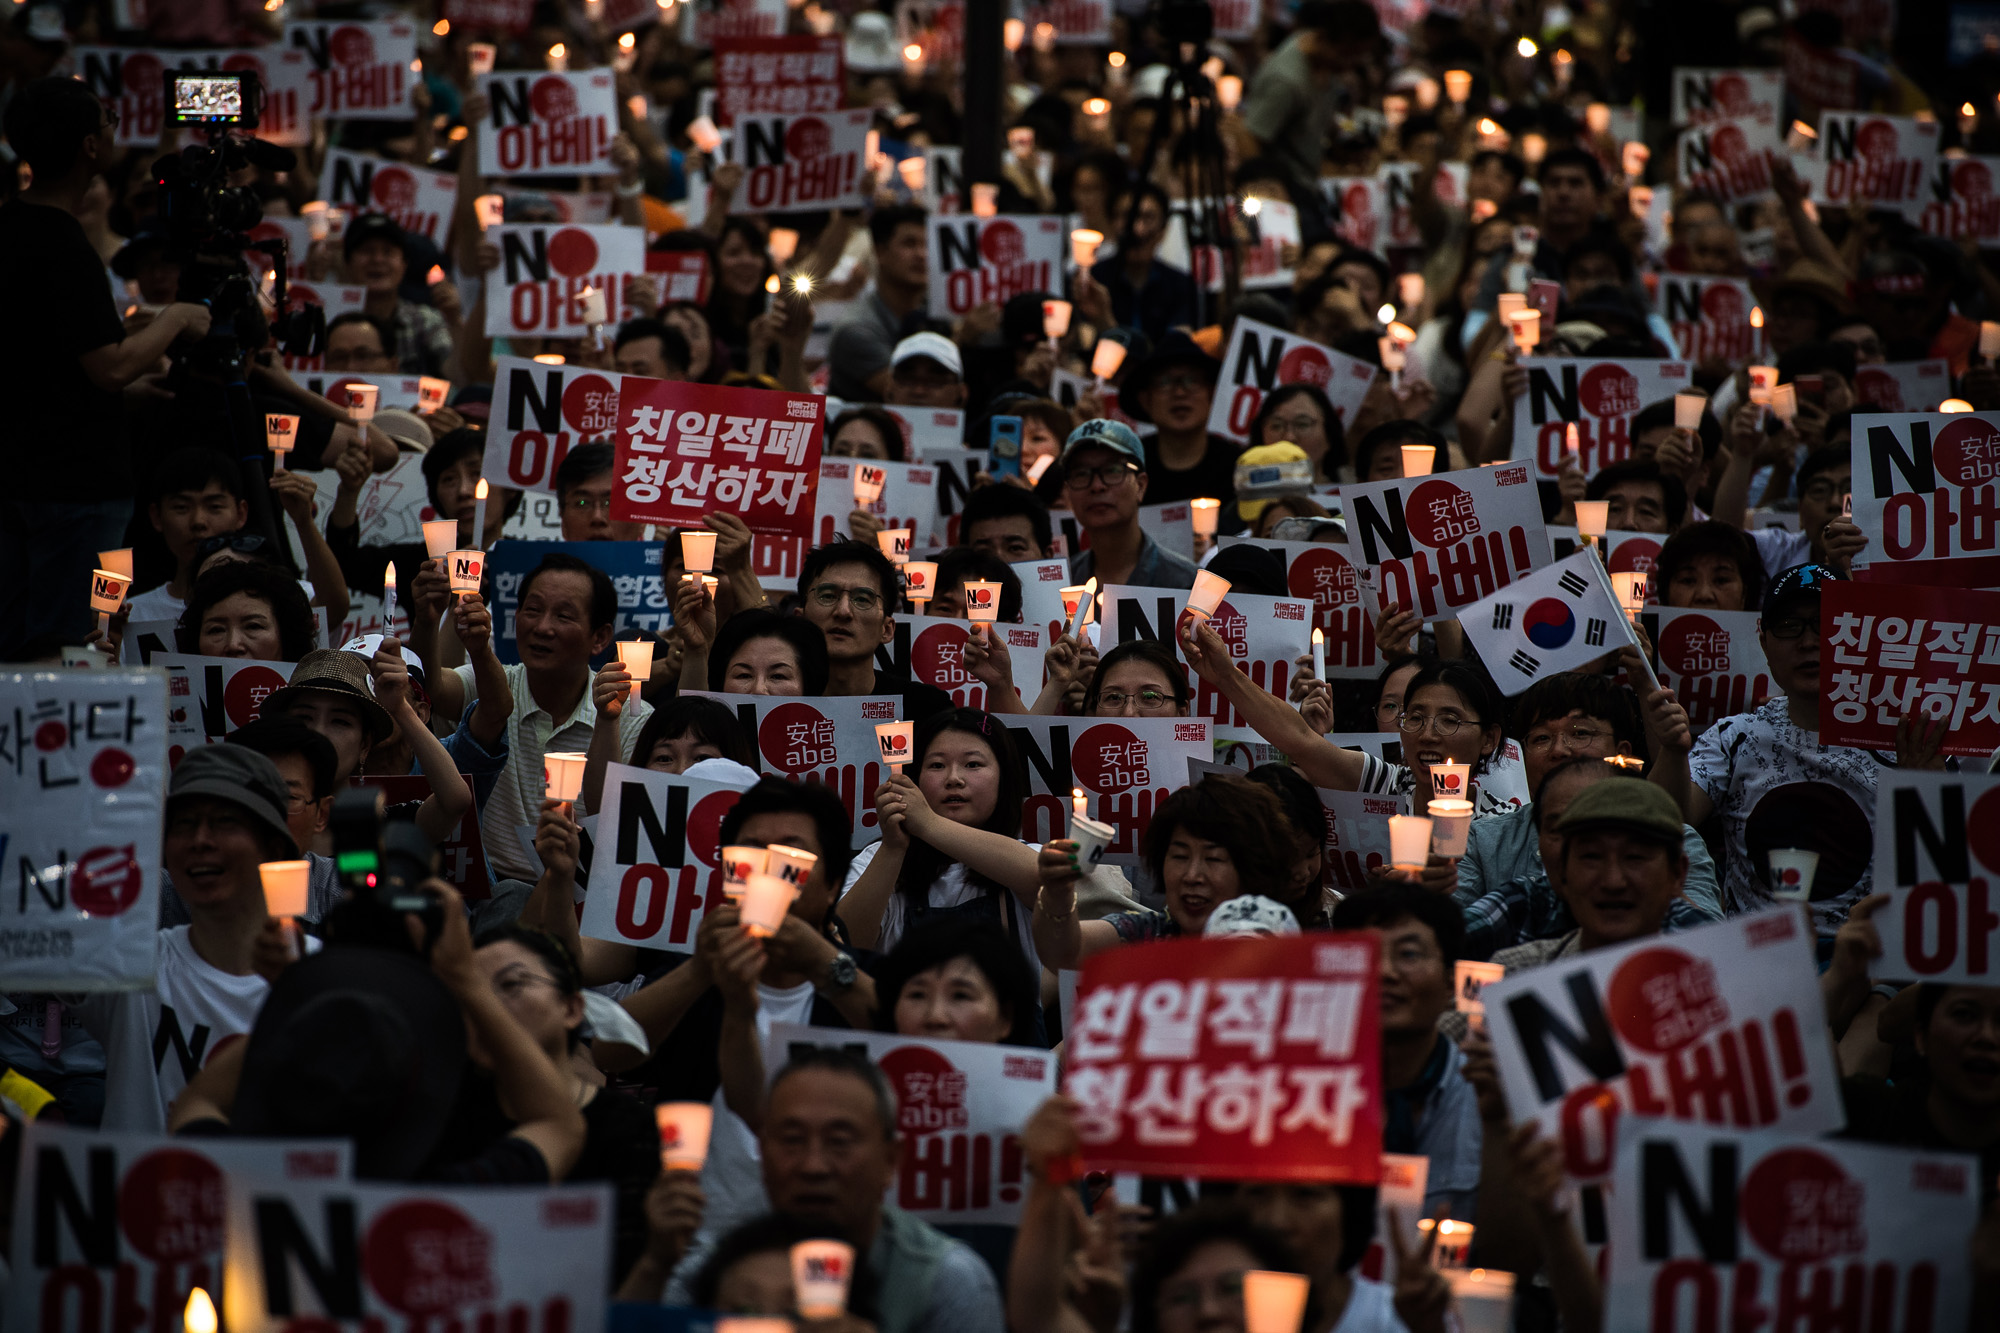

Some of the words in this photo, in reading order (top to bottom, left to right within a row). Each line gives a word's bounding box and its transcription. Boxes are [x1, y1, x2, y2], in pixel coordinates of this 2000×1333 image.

[625, 404, 815, 467] 친일적폐
[622, 455, 809, 516] 청산하자
[1428, 490, 1477, 523] 安倍
[1432, 515, 1482, 543] abe
[1685, 631, 1730, 655] 安倍
[1682, 653, 1731, 672] abe
[786, 719, 836, 747] 安倍
[1174, 723, 1206, 733] 아베규탄
[785, 746, 837, 767] abe
[1099, 740, 1149, 769] 安倍
[1098, 767, 1151, 788] abe
[1072, 977, 1366, 1063] 친일적폐
